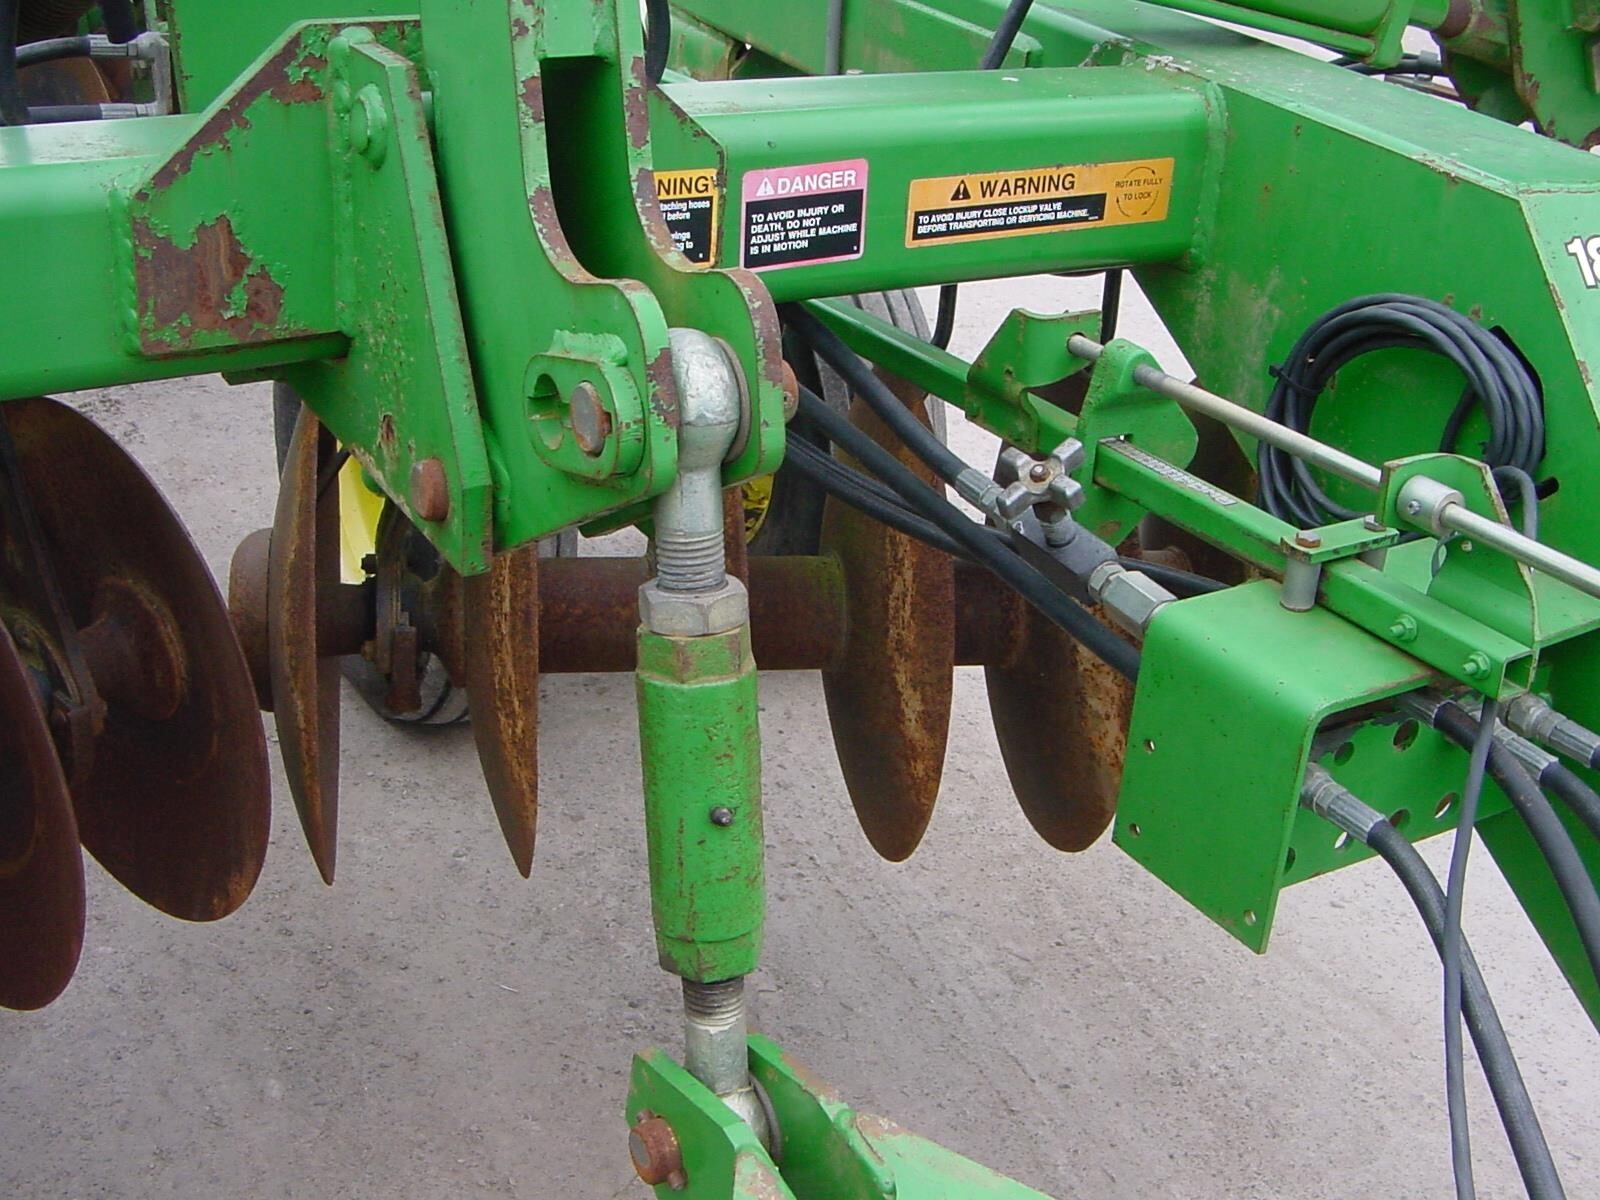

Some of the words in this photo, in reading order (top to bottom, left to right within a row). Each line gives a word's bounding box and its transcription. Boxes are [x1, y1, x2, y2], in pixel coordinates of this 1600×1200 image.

[777, 170, 856, 194] DANGER
[979, 173, 1076, 199] WARNING
[1115, 179, 1141, 188] ROTATE
[1142, 178, 1163, 186] FULLY
[1123, 193, 1133, 201] TO
[1134, 191, 1151, 200] LOCK
[751, 213, 765, 223] TO
[767, 209, 795, 221] AVOID
[797, 206, 829, 218] INJURY
[831, 203, 845, 214] OR
[917, 223, 948, 235] BEFORE
[949, 217, 1005, 231] TRANSPORTING
[1006, 215, 1017, 225] OR
[1018, 211, 1056, 224] SERVICING
[918, 215, 930, 225] TO
[930, 212, 955, 224] AVOID
[955, 210, 982, 221] INJURY
[983, 207, 1008, 218] CLOSE
[1008, 204, 1038, 216] LOCKUP
[1039, 201, 1063, 212] VALVE
[750, 222, 784, 234] DEATH,
[786, 220, 800, 229] DO
[802, 217, 821, 227] NOT
[750, 232, 785, 244] ADJUST
[787, 228, 816, 239] WHILE
[818, 222, 858, 236] MACHINE
[749, 246, 759, 255] IS
[761, 244, 771, 253] IN
[772, 239, 809, 252] MOTION
